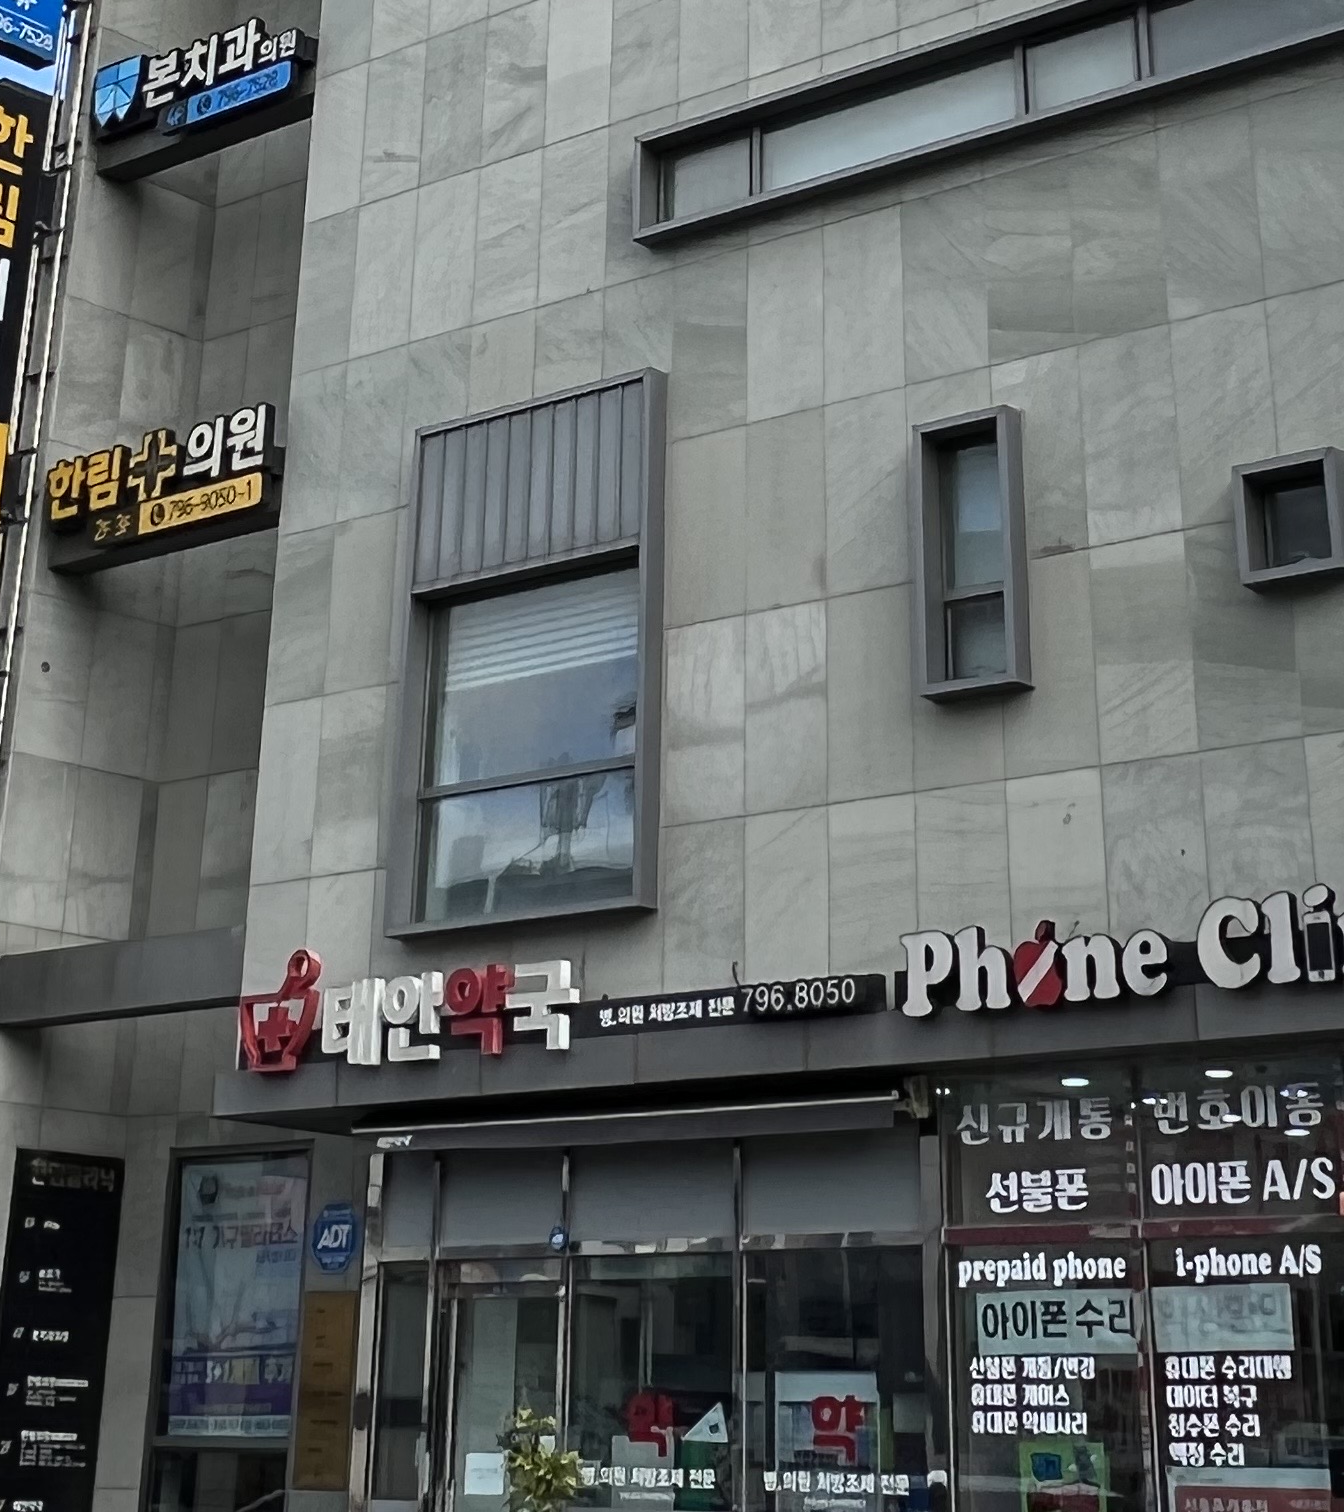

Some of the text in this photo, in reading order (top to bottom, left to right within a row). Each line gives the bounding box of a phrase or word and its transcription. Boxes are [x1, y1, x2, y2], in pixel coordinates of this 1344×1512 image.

[899, 920, 1171, 1017] Phone
[321, 959, 580, 1066] 태안약국
[741, 978, 856, 1012] 796.8050
[957, 1097, 1112, 1145] 신규개통
[1154, 1083, 1324, 1135] 번호이동
[986, 1168, 1089, 1213] 선불폰
[1151, 1160, 1252, 1205] 아이폰
[1263, 1157, 1336, 1201] A/S
[317, 1224, 352, 1250] ADT
[958, 1251, 1127, 1287] prepaid phone
[1175, 1244, 1322, 1283] i-phone A/S
[981, 1299, 1068, 1340] 아이폰
[1076, 1298, 1135, 1339] 수리
[811, 1393, 865, 1466] 약
[1224, 1413, 1261, 1437] 수리
[1209, 1442, 1245, 1467] 수리
